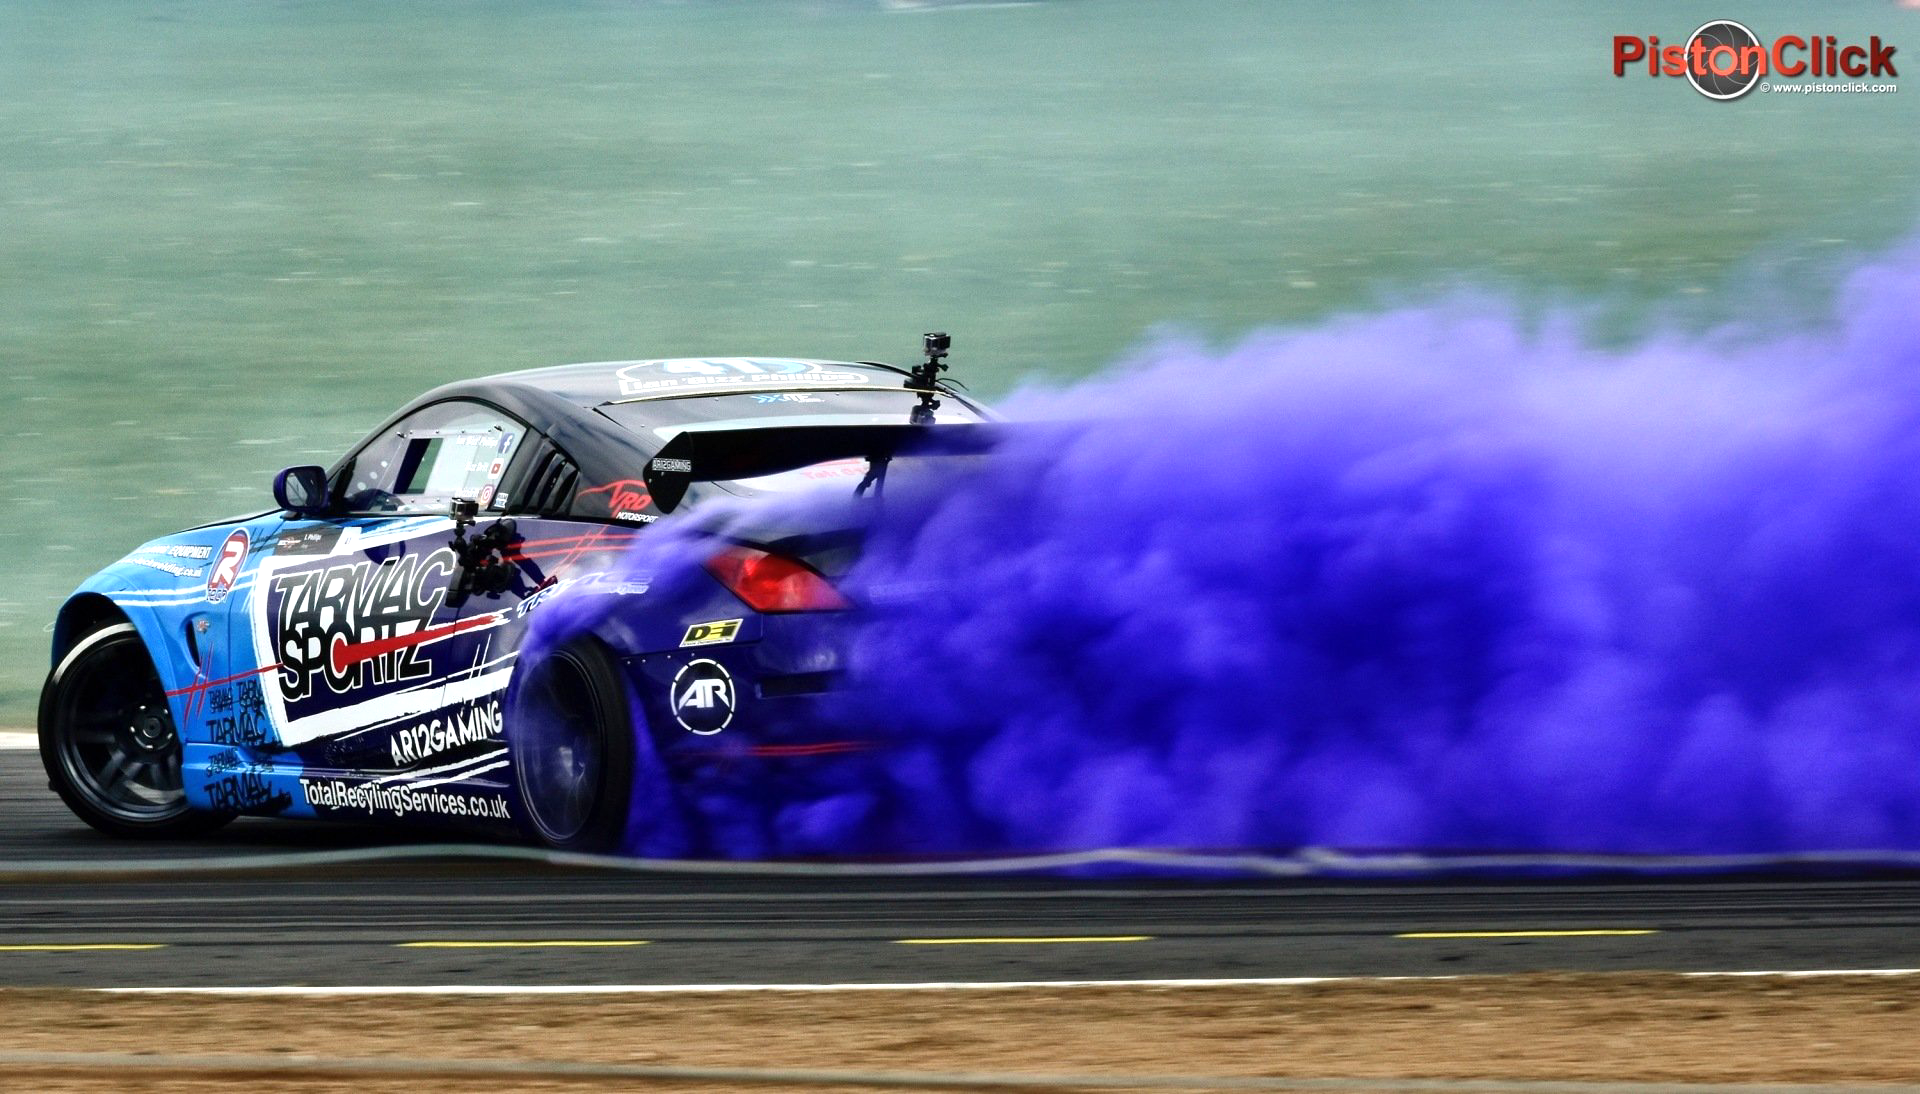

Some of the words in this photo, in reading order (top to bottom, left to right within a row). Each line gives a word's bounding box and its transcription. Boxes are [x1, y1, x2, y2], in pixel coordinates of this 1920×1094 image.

[653, 458, 691, 472] AR12GAMING
[168, 545, 213, 559] EQUIPMENT
[275, 547, 457, 632] TARMAC
[277, 615, 432, 703] SPORTZ
[205, 709, 267, 746] TARMAC
[390, 699, 503, 766] AR12GAMING
[299, 778, 511, 820] TotalRecylingServices.co.uk
